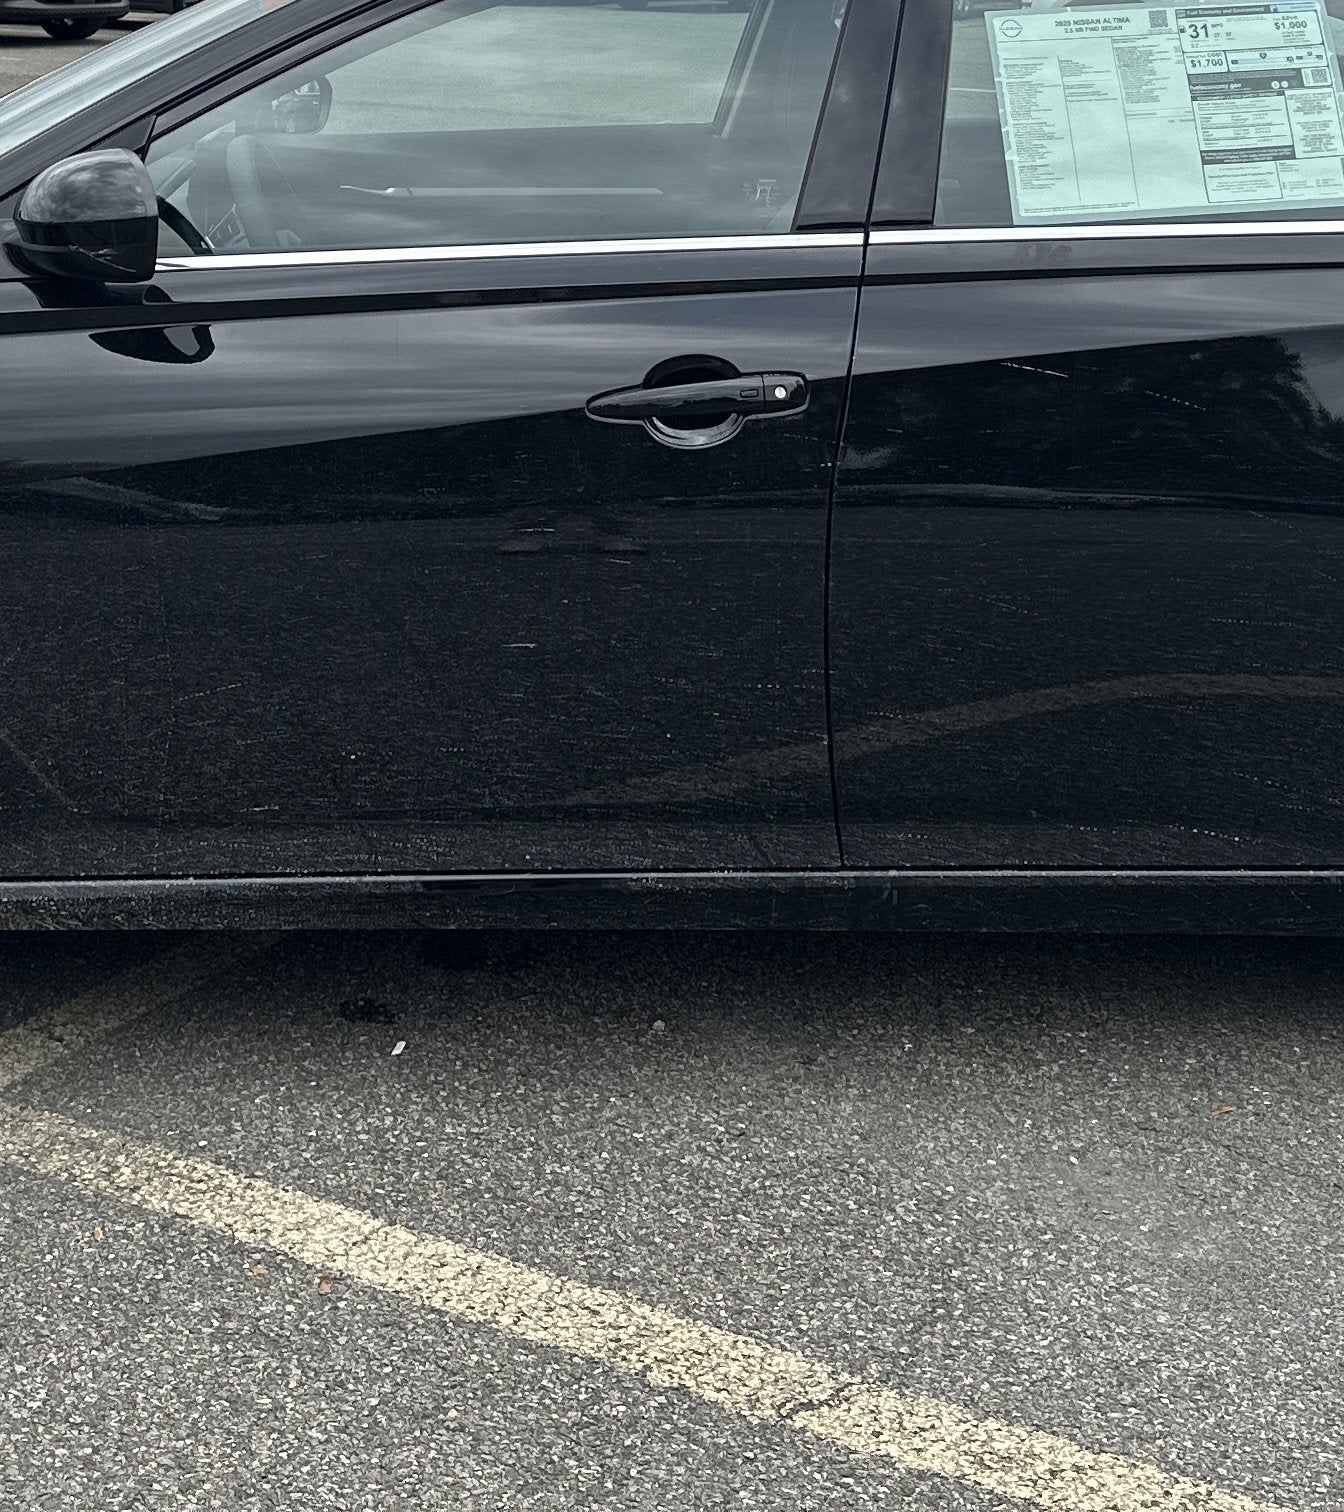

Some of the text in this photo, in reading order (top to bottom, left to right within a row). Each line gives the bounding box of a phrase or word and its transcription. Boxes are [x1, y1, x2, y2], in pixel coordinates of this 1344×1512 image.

[1274, 20, 1307, 30] $1,000
[1188, 23, 1209, 39] 31
[1191, 58, 1223, 68] $1,700
